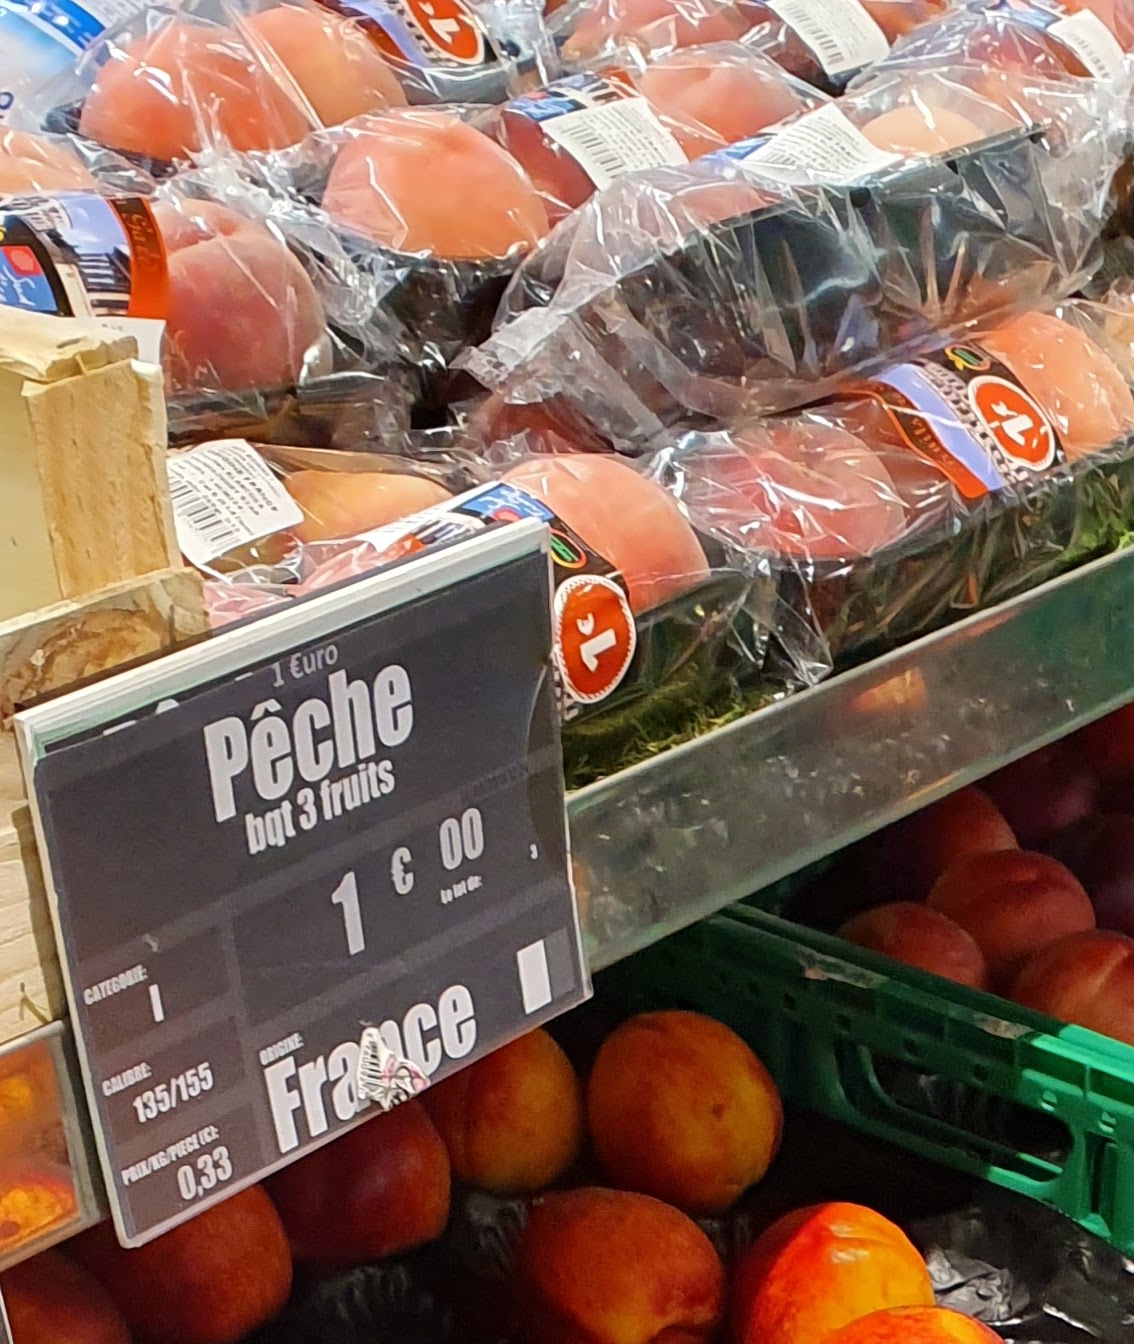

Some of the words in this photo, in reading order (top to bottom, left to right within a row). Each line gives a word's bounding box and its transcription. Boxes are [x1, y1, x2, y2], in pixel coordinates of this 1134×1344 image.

[271, 661, 285, 688] 1
[289, 644, 339, 680] €uro
[203, 664, 414, 823] Pêche
[244, 800, 296, 855] bqt
[296, 787, 318, 831] 3
[319, 760, 396, 821] fruits
[331, 871, 366, 956] 1
[391, 846, 415, 896] €
[439, 807, 485, 871] 00
[259, 1031, 304, 1066] ORIGINE:
[102, 1061, 152, 1097] CALIBRE:
[132, 1061, 214, 1124] 135/155
[176, 1144, 234, 1202] 0,33
